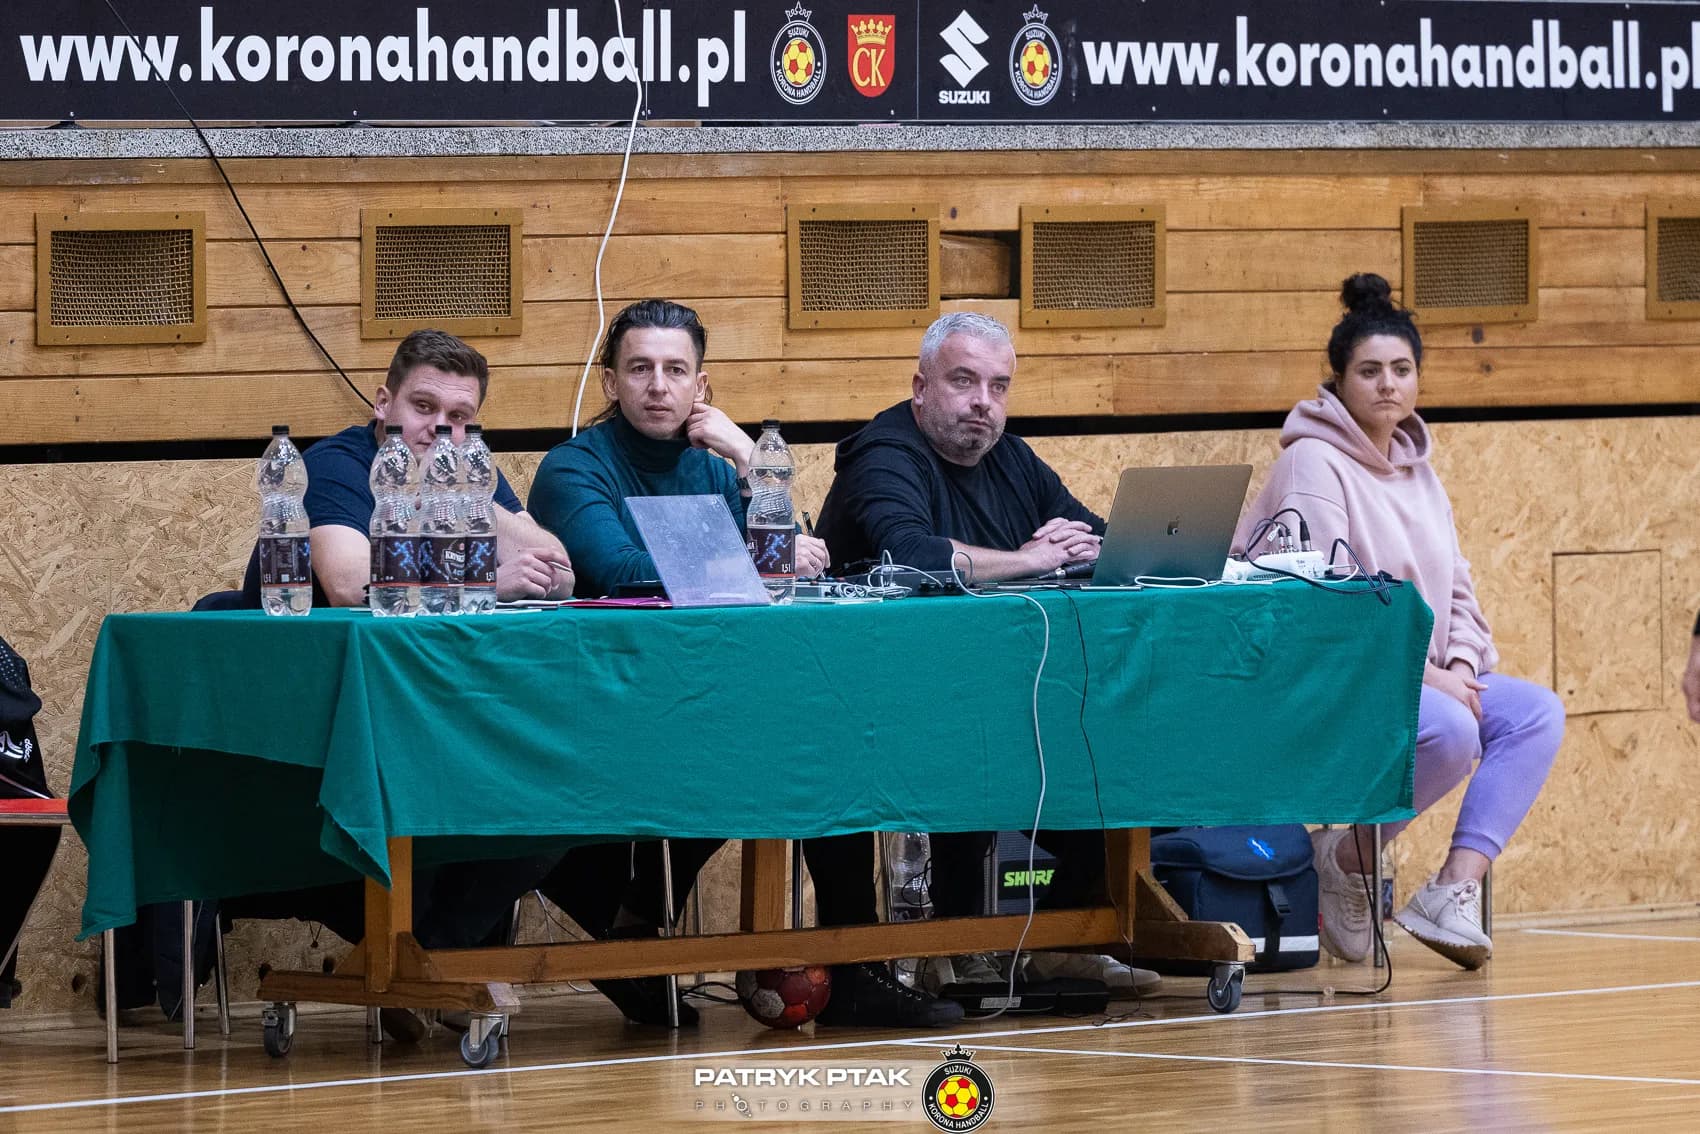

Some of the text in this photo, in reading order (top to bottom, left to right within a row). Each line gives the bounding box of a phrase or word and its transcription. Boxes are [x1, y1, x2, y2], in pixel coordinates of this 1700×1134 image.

[787, 26, 810, 39] SUZUKI
[19, 6, 747, 108] www.koronahandball.pl
[852, 47, 886, 87] CK
[1081, 15, 1700, 113] www.koronahandball.pl
[775, 68, 822, 98] KORONA HANDBALL
[938, 90, 990, 104] SUZUKI
[1014, 70, 1058, 100] KORONA HANDBALL
